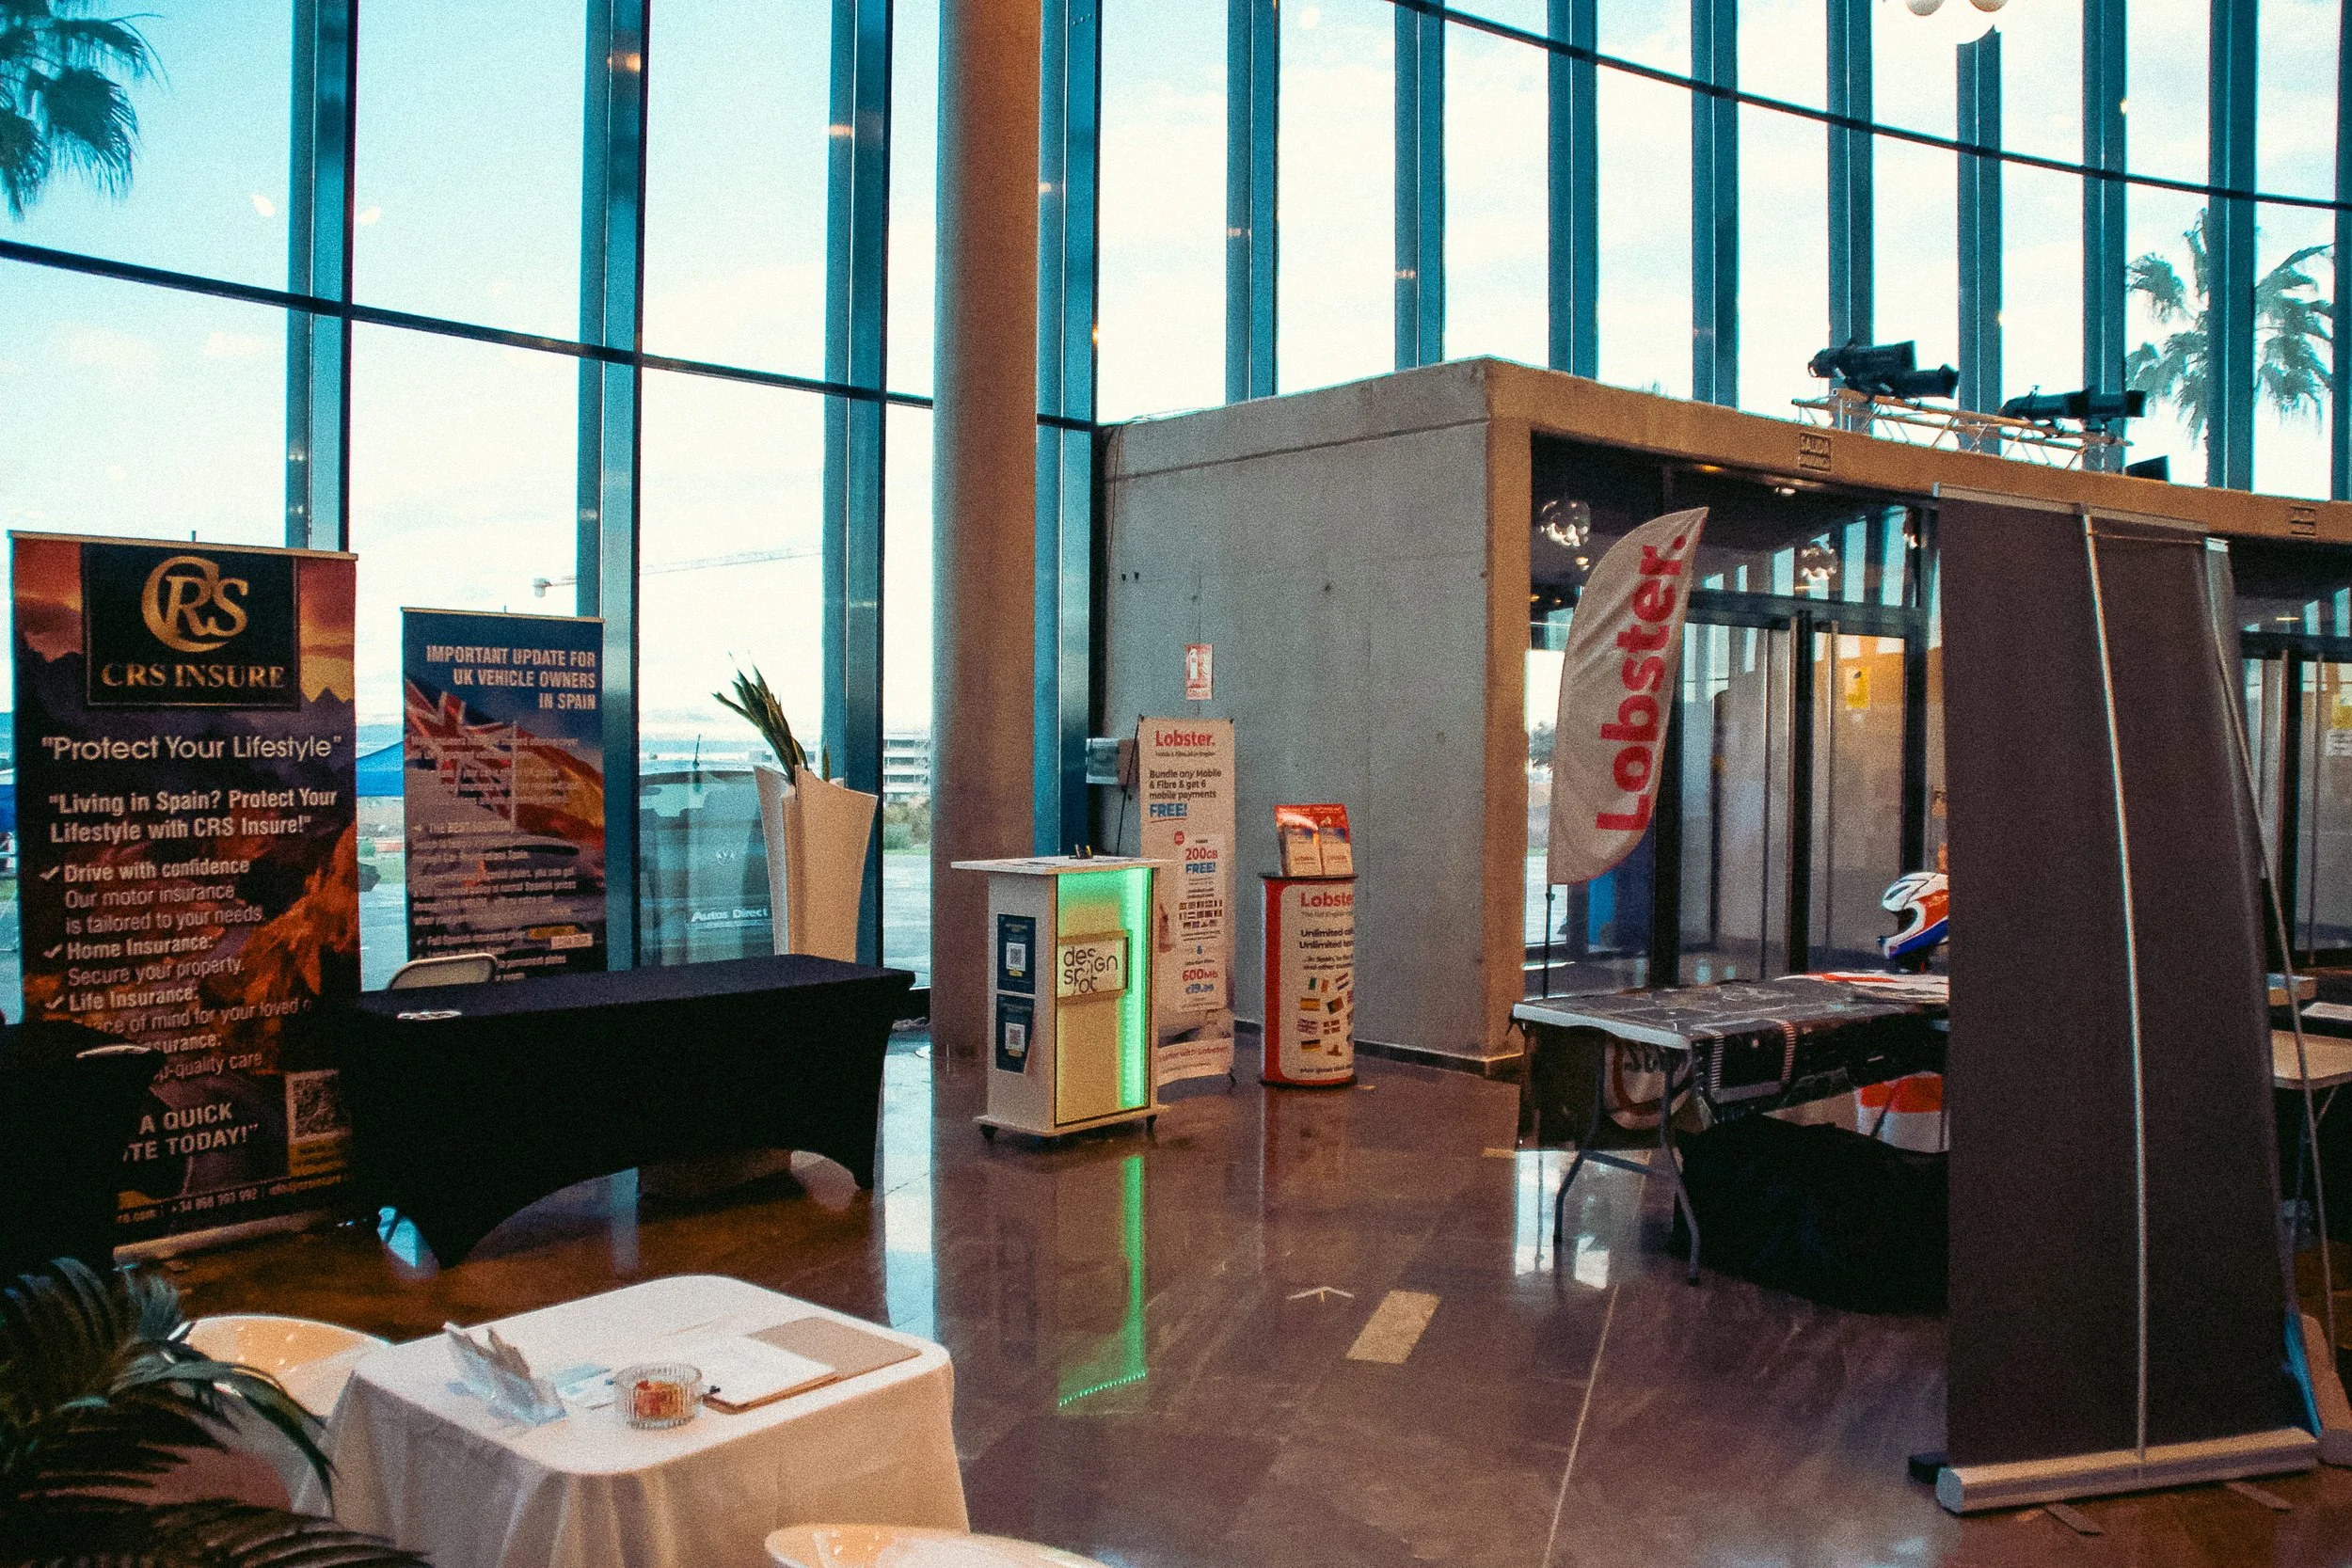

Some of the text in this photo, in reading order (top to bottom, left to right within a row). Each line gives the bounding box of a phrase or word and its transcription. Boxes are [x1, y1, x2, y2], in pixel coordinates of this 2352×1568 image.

[426, 645, 596, 668] IMPORTANT UPDATE FOR
[101, 662, 286, 689] CRS INSURE
[453, 668, 596, 689] UK VEHICLE OWNERS
[1596, 533, 1688, 831] Lobster.
[539, 692, 596, 709] IN SPAIN
[165, 736, 225, 759] Your
[1155, 730, 1216, 747] Lobster.
[1149, 768, 1222, 780] Bundle any Mobile
[1149, 780, 1207, 790] & Fibre & get 6
[131, 791, 150, 812] in
[156, 789, 221, 815] Spain?
[229, 789, 294, 811] Protect
[298, 787, 339, 807] Your
[1149, 790, 1217, 801] mobile payments
[1150, 802, 1188, 817] FREE!
[50, 819, 142, 845] Lifestyle
[148, 819, 188, 840] with
[194, 816, 234, 838] CRS
[1185, 847, 1218, 861] 200GB
[64, 858, 251, 883] Drive with confidence
[1185, 862, 1216, 874] FREE!
[65, 884, 235, 909] Our motor insurance
[1300, 891, 1354, 908] Lobste
[66, 905, 266, 935] is tailored to your needs.
[1300, 927, 1343, 938] Unlimited
[67, 935, 214, 960] Home Insurance:
[1299, 940, 1343, 949] Unlimited
[68, 957, 246, 987] Secure your property.
[69, 987, 199, 1012] Life Insurance:
[129, 1015, 146, 1033] of
[151, 1012, 190, 1031] mind
[195, 1006, 215, 1025] for
[219, 1006, 256, 1025] your
[260, 997, 299, 1017] loved
[229, 1052, 262, 1069] care
[139, 1101, 233, 1135] A QUICK
